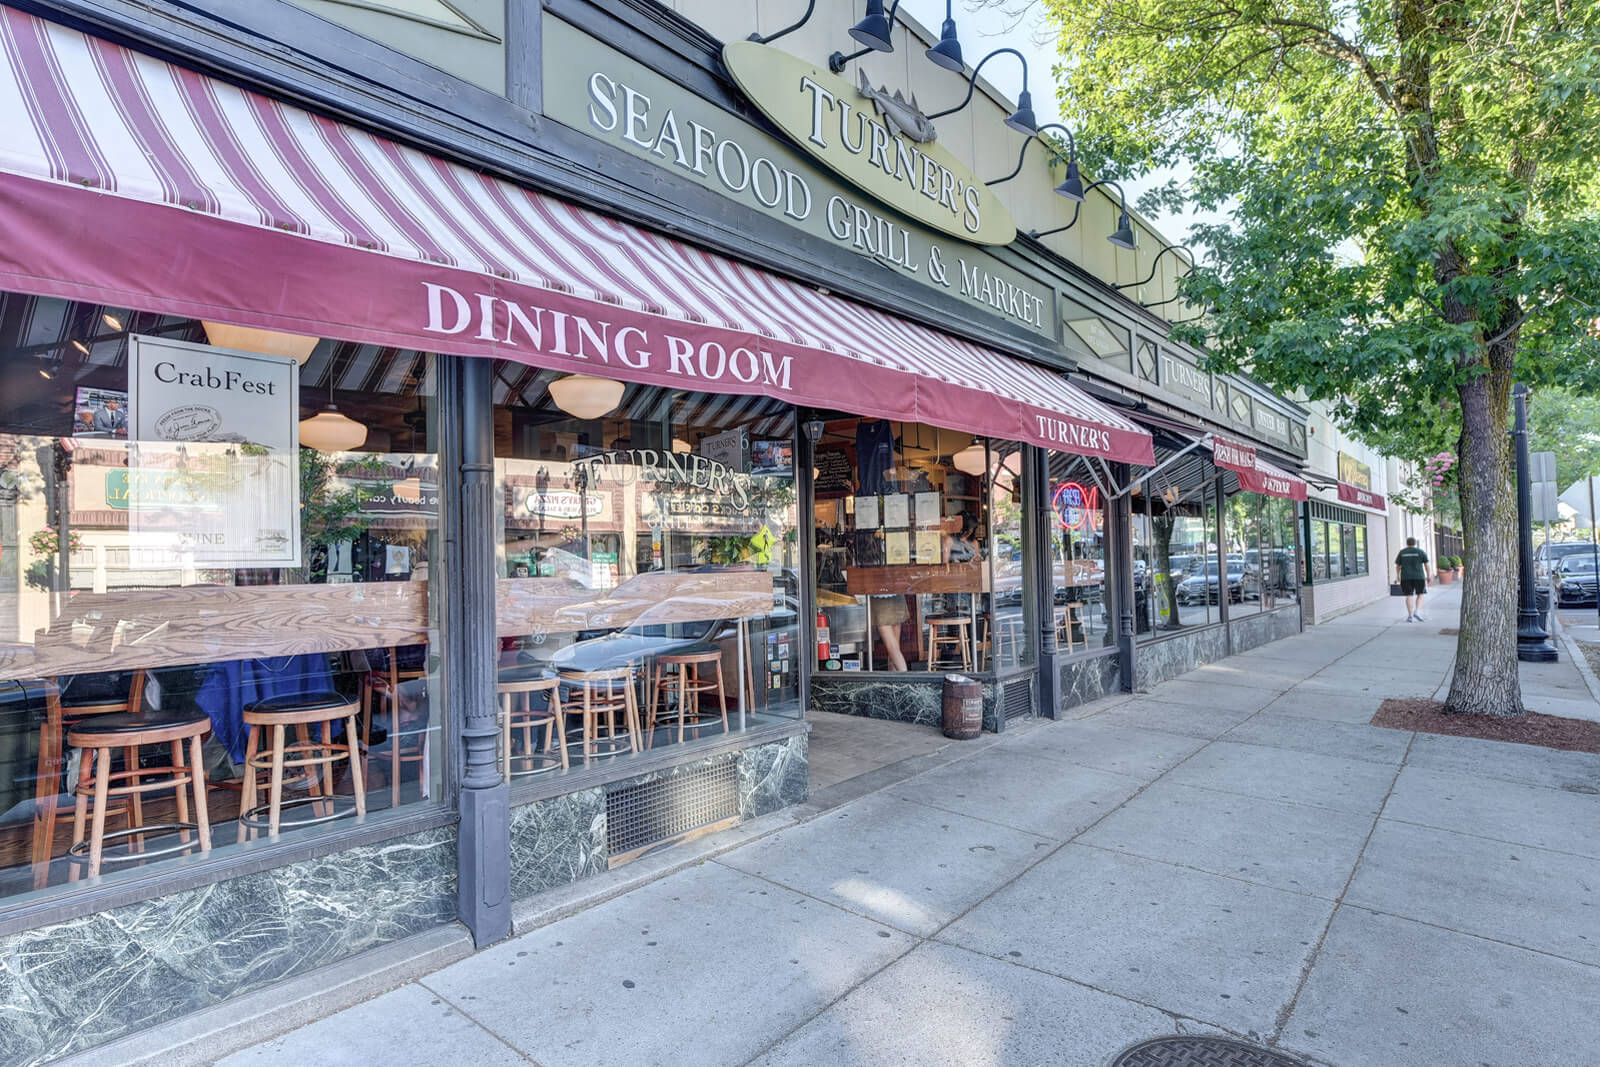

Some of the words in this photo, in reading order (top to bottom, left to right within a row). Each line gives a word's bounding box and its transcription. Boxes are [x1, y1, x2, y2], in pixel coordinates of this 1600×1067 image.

[800, 77, 981, 233] TURNER'S
[588, 72, 812, 220] SEAFOOD
[827, 195, 918, 273] GRILL
[928, 245, 950, 287] &
[958, 258, 1043, 328] MARKET
[154, 361, 277, 396] CrabFest
[421, 281, 652, 369] DINING
[663, 334, 794, 391] ROOM
[1035, 415, 1110, 451] TURNER'S
[571, 449, 751, 511] TURNER'S
